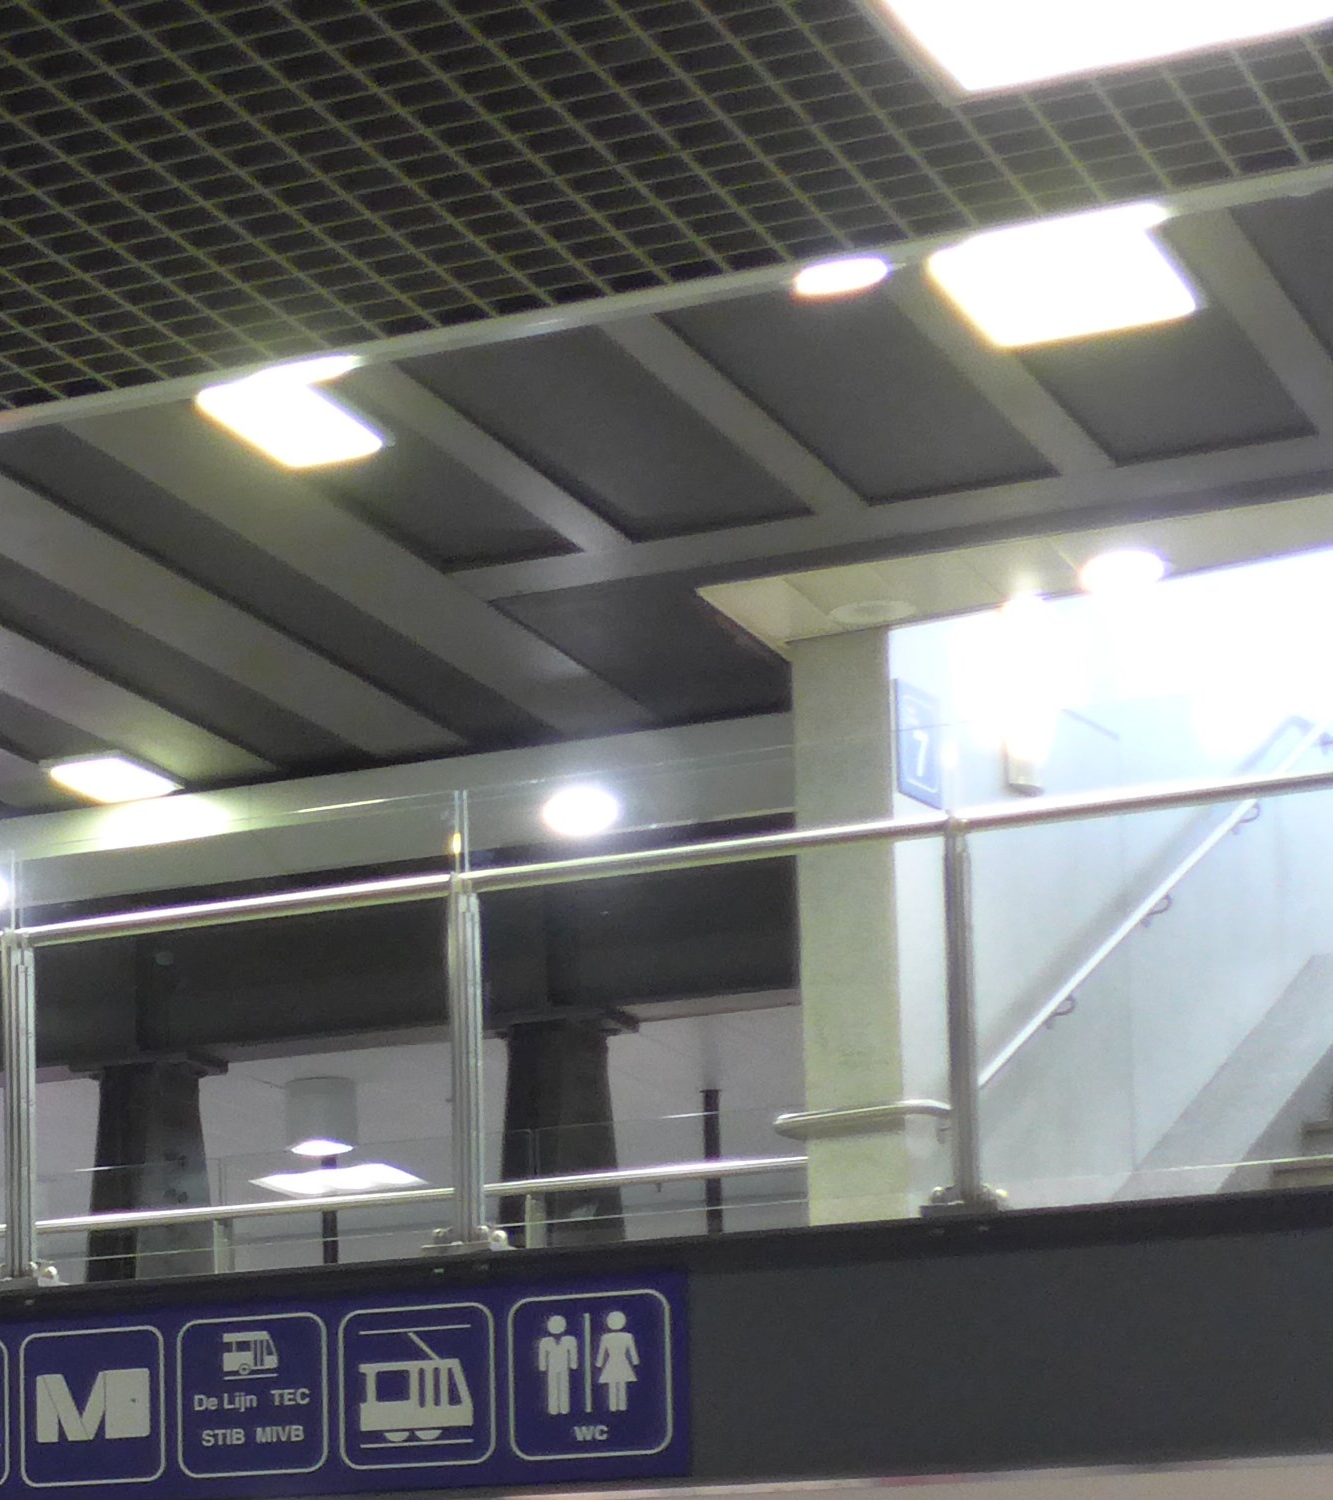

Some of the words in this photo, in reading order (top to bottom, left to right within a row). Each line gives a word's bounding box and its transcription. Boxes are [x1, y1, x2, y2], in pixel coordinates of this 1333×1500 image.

[193, 1394, 219, 1411] De
[223, 1392, 258, 1413] Lijn
[270, 1388, 311, 1406] TEC
[201, 1428, 246, 1447] STIB
[255, 1425, 304, 1444] MIVB
[573, 1425, 609, 1441] WC
